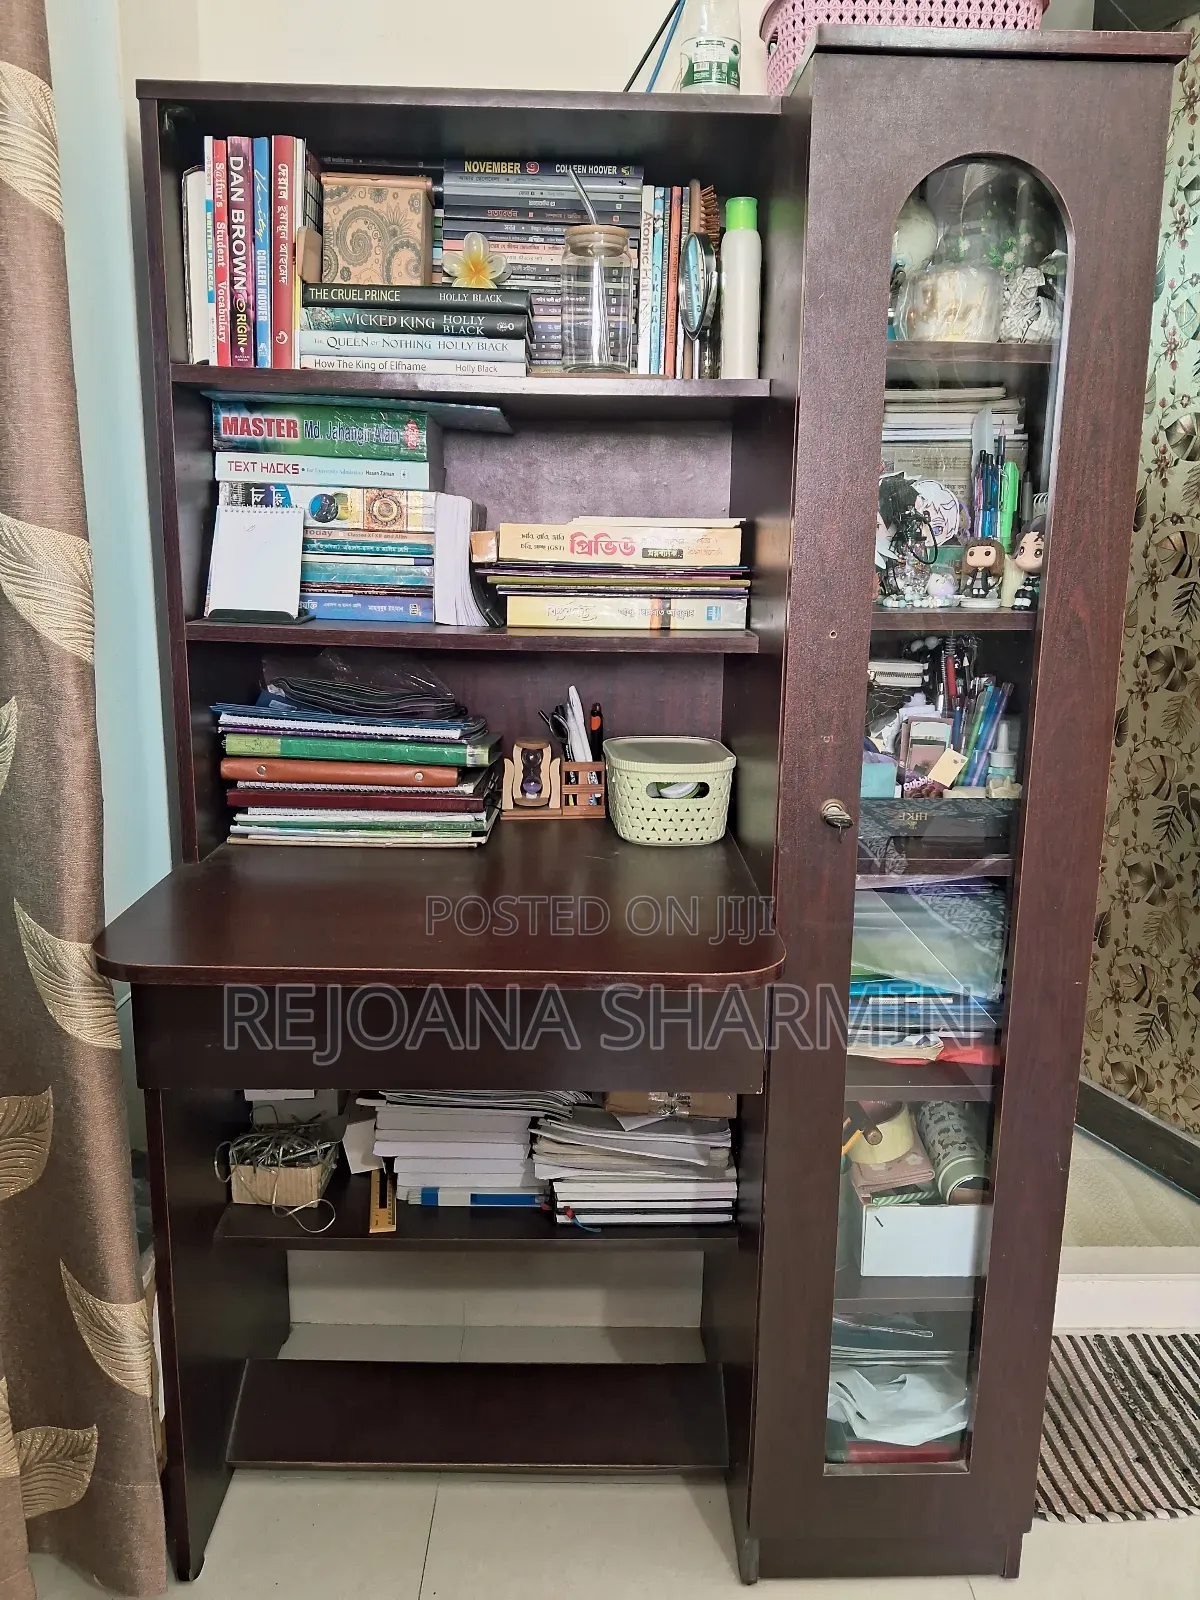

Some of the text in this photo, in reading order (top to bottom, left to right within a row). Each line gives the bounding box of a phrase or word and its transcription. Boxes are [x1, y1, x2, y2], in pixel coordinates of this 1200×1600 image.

[464, 160, 540, 174] NOVEMBER 9
[588, 164, 617, 175] HOOVER
[254, 169, 268, 243] Verity
[229, 156, 247, 290] DAN BROWN
[216, 221, 226, 267] Student
[641, 210, 654, 265] Atomic
[256, 249, 268, 321] COLLEEN HOOVER
[309, 287, 400, 302] THE CRUEL PRINCE
[439, 292, 502, 303] HOLLY BLACK
[217, 281, 228, 343] Vocabulary
[342, 312, 398, 327] WICKED
[400, 316, 436, 332] KING
[442, 315, 486, 326] HOLLY
[442, 325, 485, 336] BLACK
[326, 336, 369, 350] QUEEN
[381, 338, 432, 350] NOTHING
[438, 341, 509, 352] HOLLY BLACK
[314, 359, 427, 372] How The King of Elfhame
[455, 363, 498, 374] Holly Black
[222, 416, 400, 447] MASTER Md. Jahangir Alam
[228, 460, 300, 475] TEXT HACKS
[569, 531, 637, 557] প্রিভিউ
